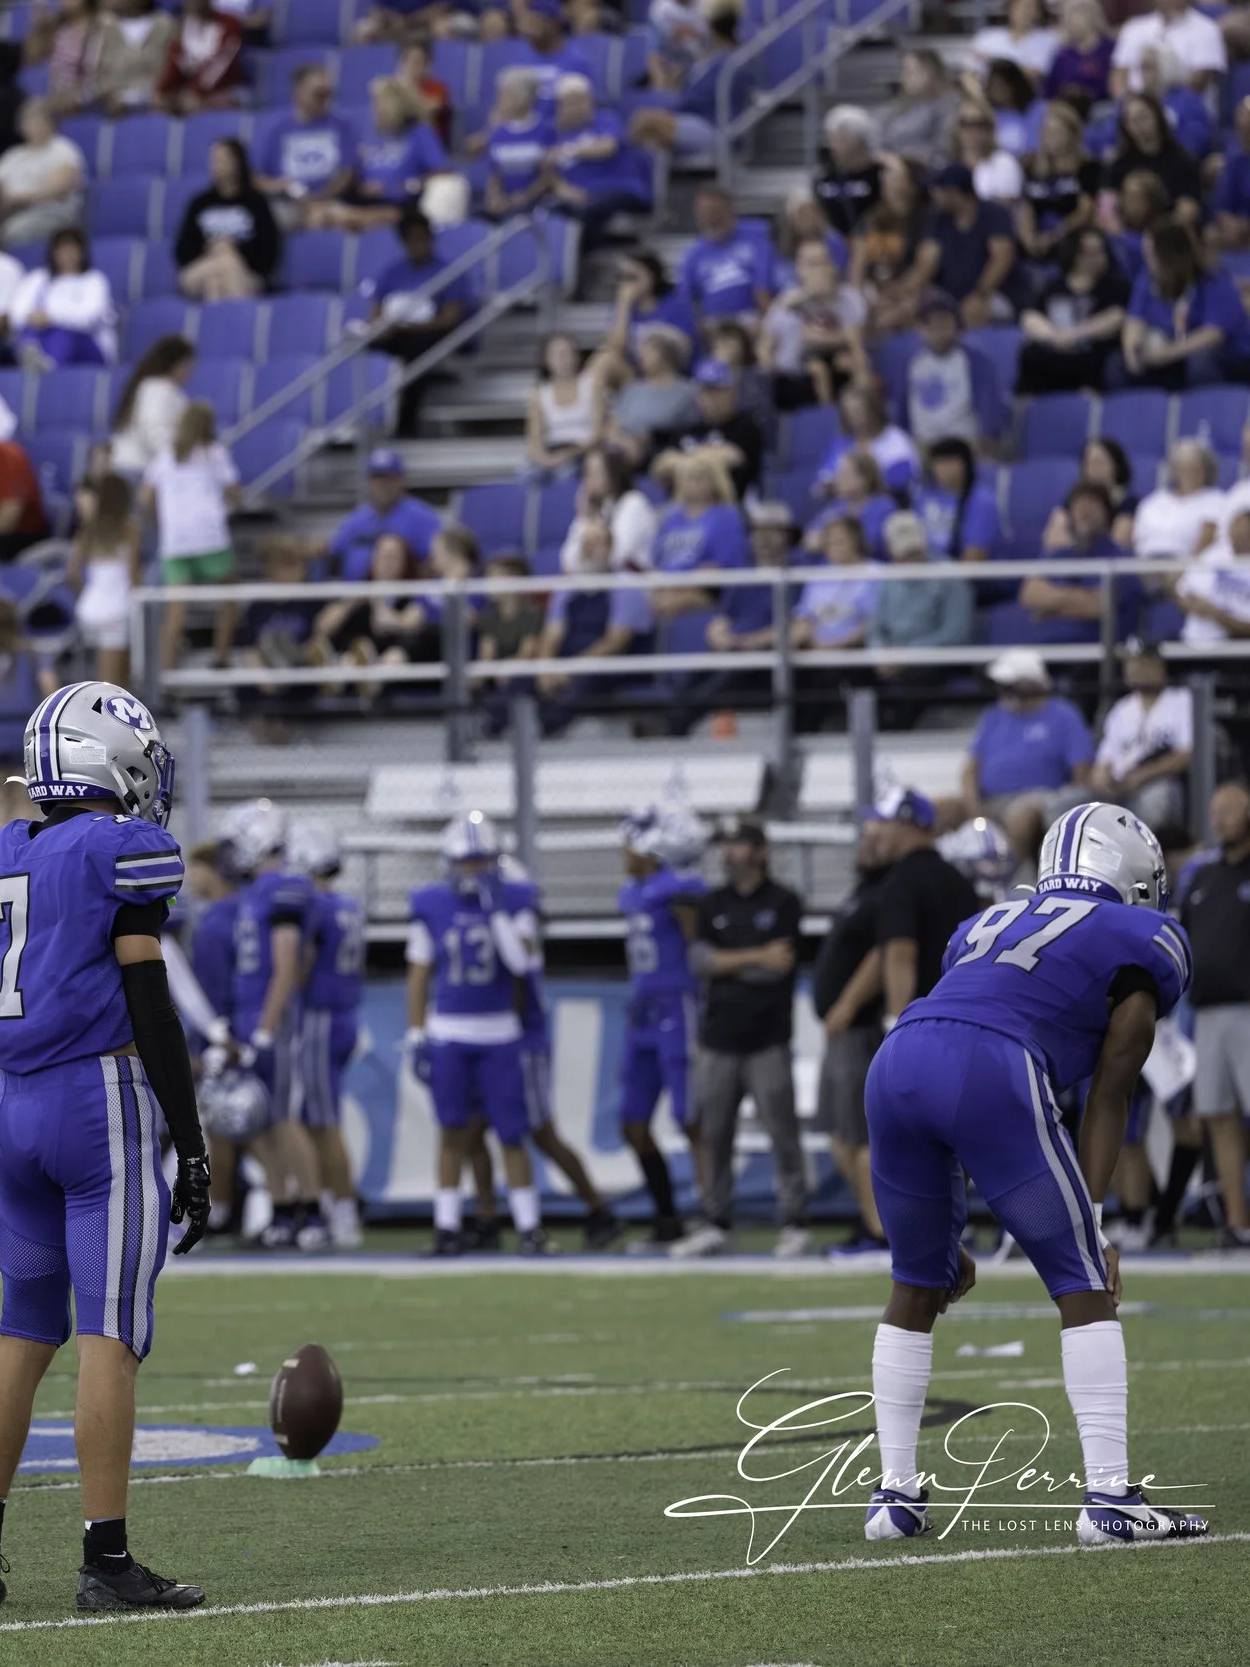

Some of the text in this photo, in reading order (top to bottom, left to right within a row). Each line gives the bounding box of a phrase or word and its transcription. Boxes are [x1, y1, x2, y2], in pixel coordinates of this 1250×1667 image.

[111, 698, 150, 730] M
[49, 785, 88, 797] WAY
[1064, 877, 1102, 893] WAY
[953, 897, 1099, 973] 97
[441, 924, 496, 987] 13
